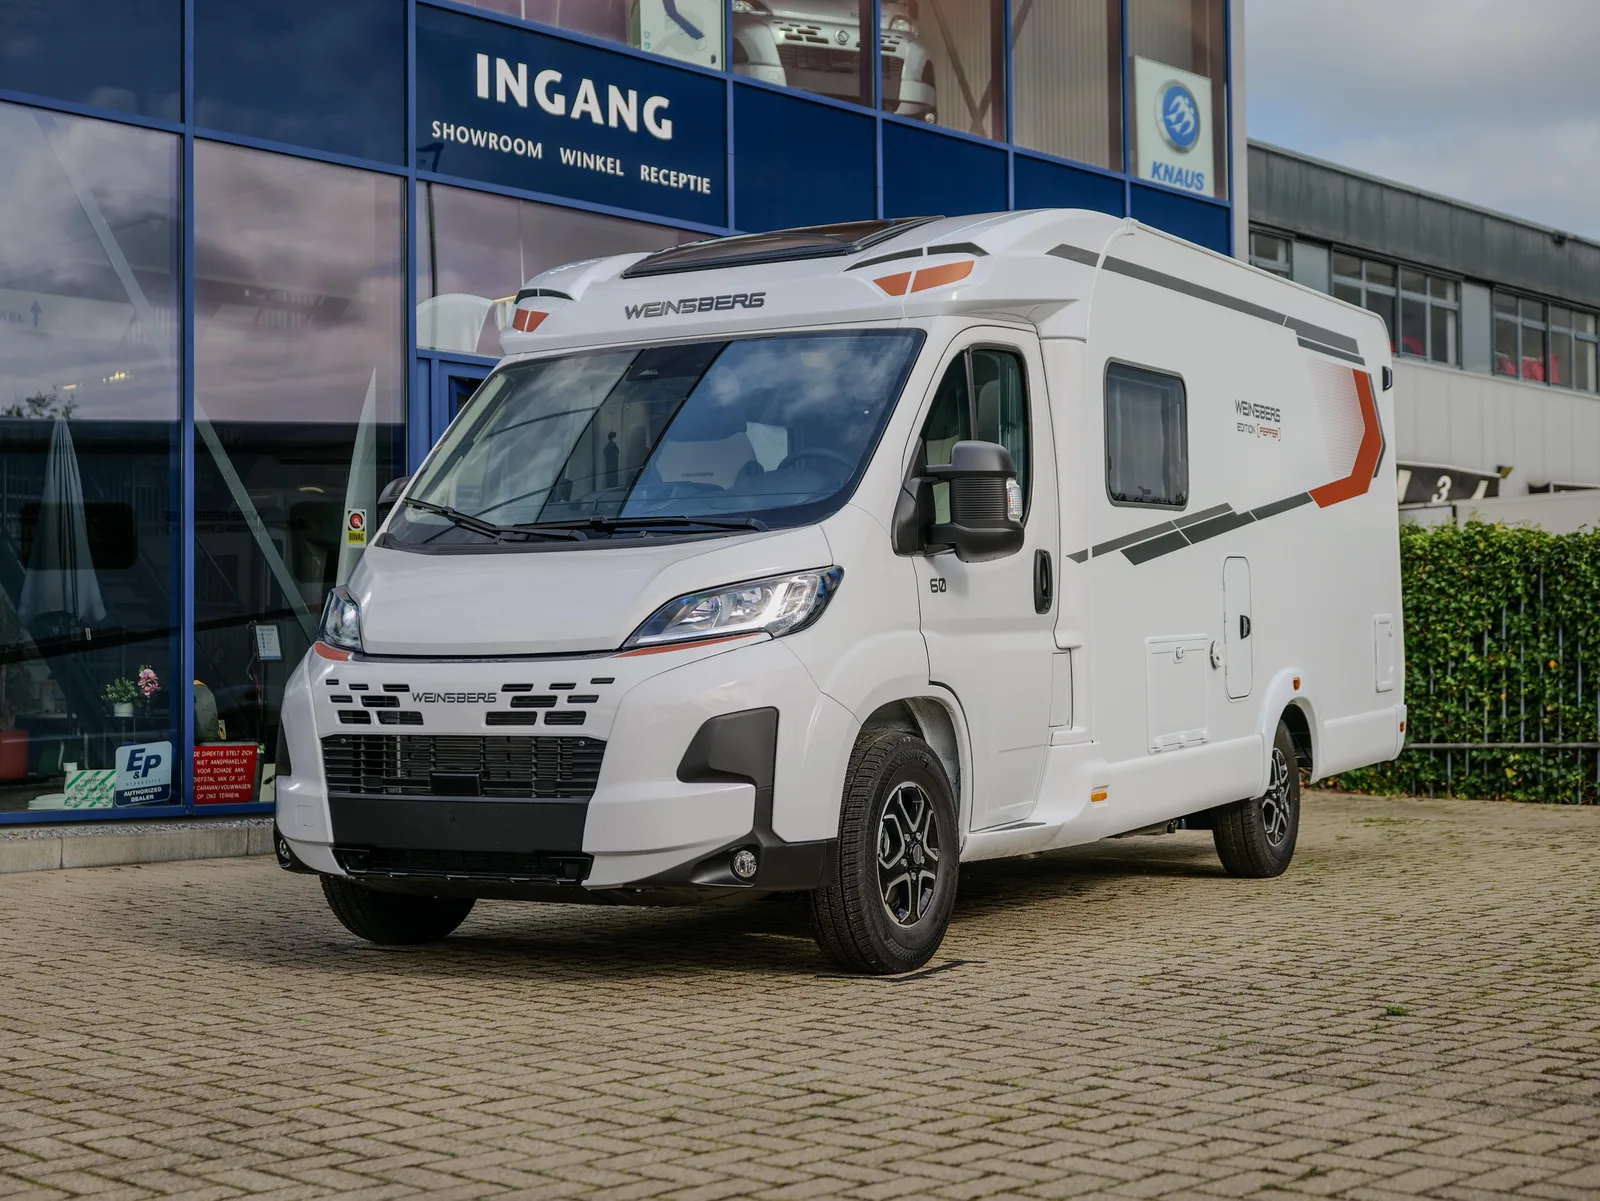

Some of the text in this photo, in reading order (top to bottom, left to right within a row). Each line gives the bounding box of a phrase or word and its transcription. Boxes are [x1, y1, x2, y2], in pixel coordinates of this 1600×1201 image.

[475, 52, 674, 140] INGANG
[431, 120, 712, 194] SHOWROOM WINKEL RECEPTIE
[1152, 160, 1205, 190] KNAUS
[625, 292, 766, 320] WEINSBERG
[1235, 399, 1281, 423] WEINSBERG
[1237, 422, 1256, 434] EDITION
[1431, 475, 1452, 503] 3
[349, 532, 364, 541] BOVAG
[930, 577, 947, 593] 60
[412, 692, 497, 704] WEINSBERG
[123, 786, 162, 797] AUTHORIZED
[130, 794, 155, 803] DEALER
